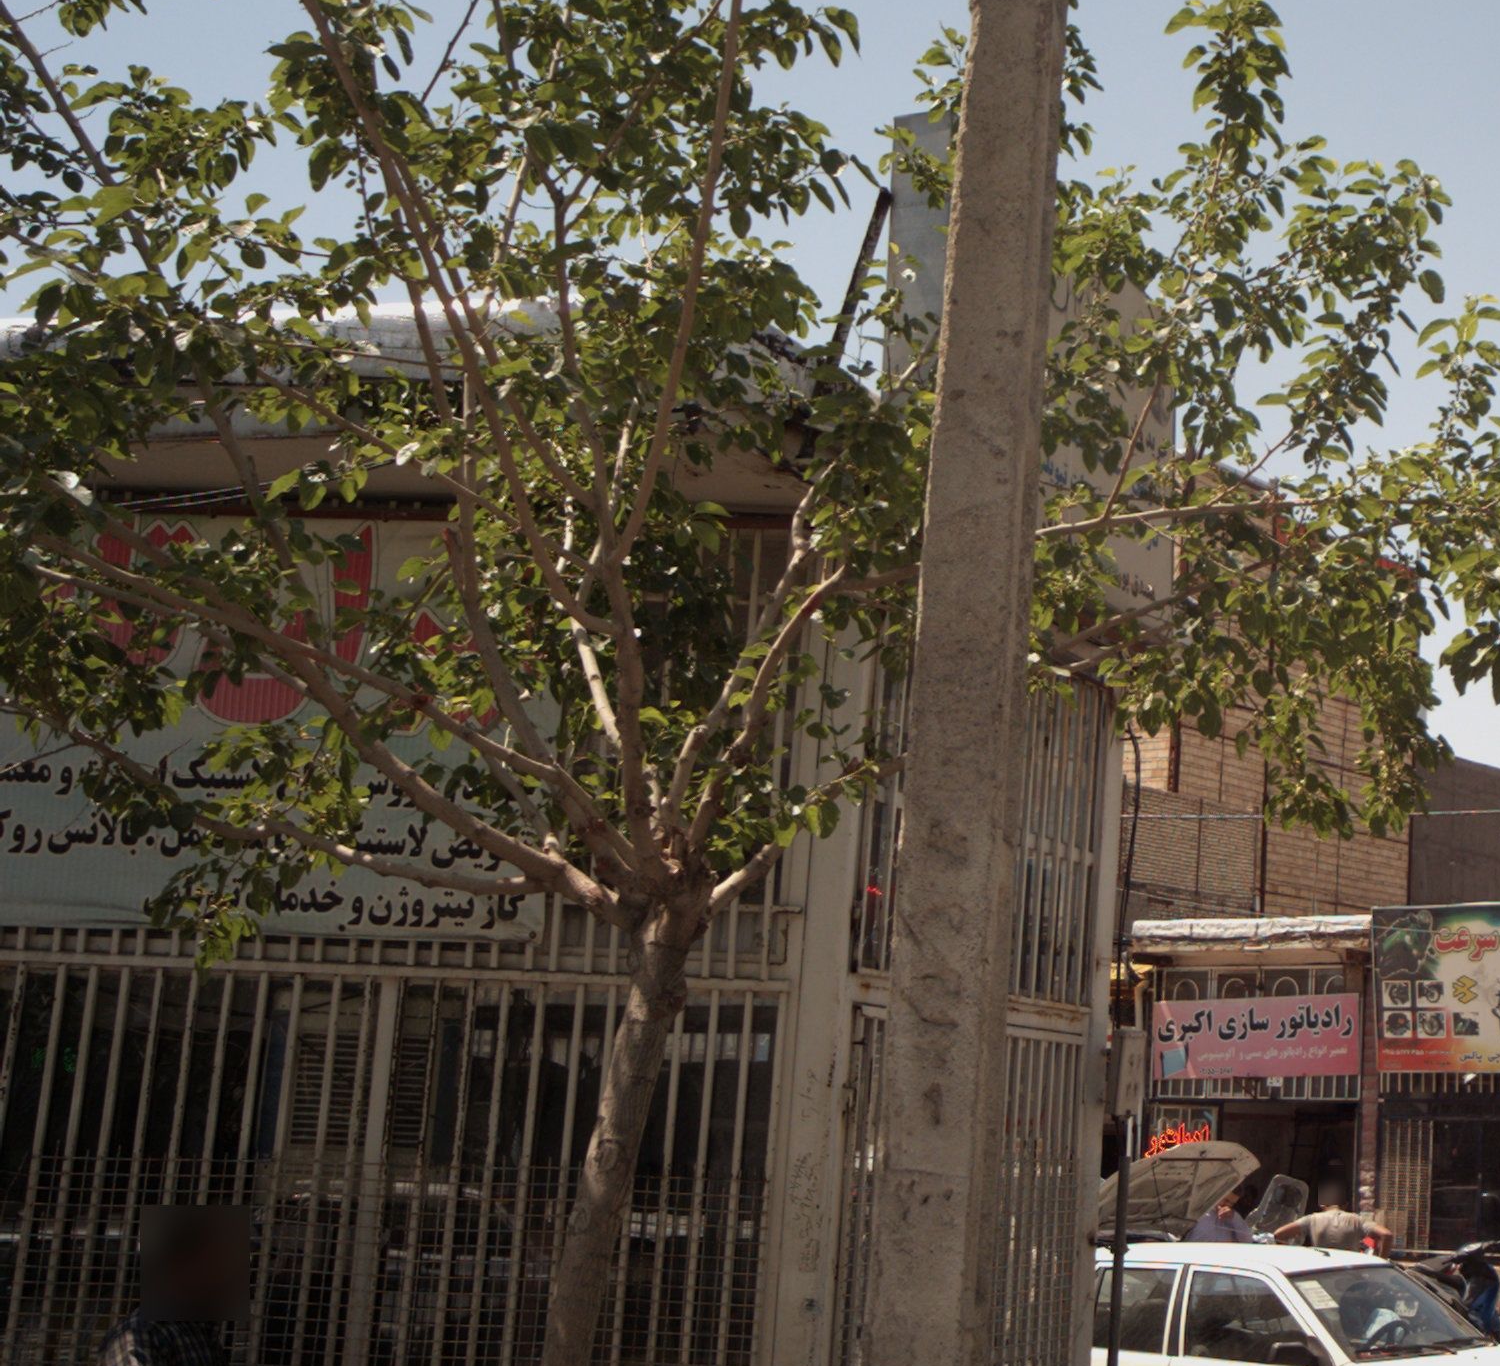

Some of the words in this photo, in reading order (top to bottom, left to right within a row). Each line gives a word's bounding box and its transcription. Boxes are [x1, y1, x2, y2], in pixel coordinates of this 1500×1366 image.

[1434, 926, 1500, 961] سرعت
[1157, 1008, 1214, 1043] اکبری
[1218, 1006, 1270, 1041] سازی
[1275, 1001, 1354, 1040] رادیاتور
